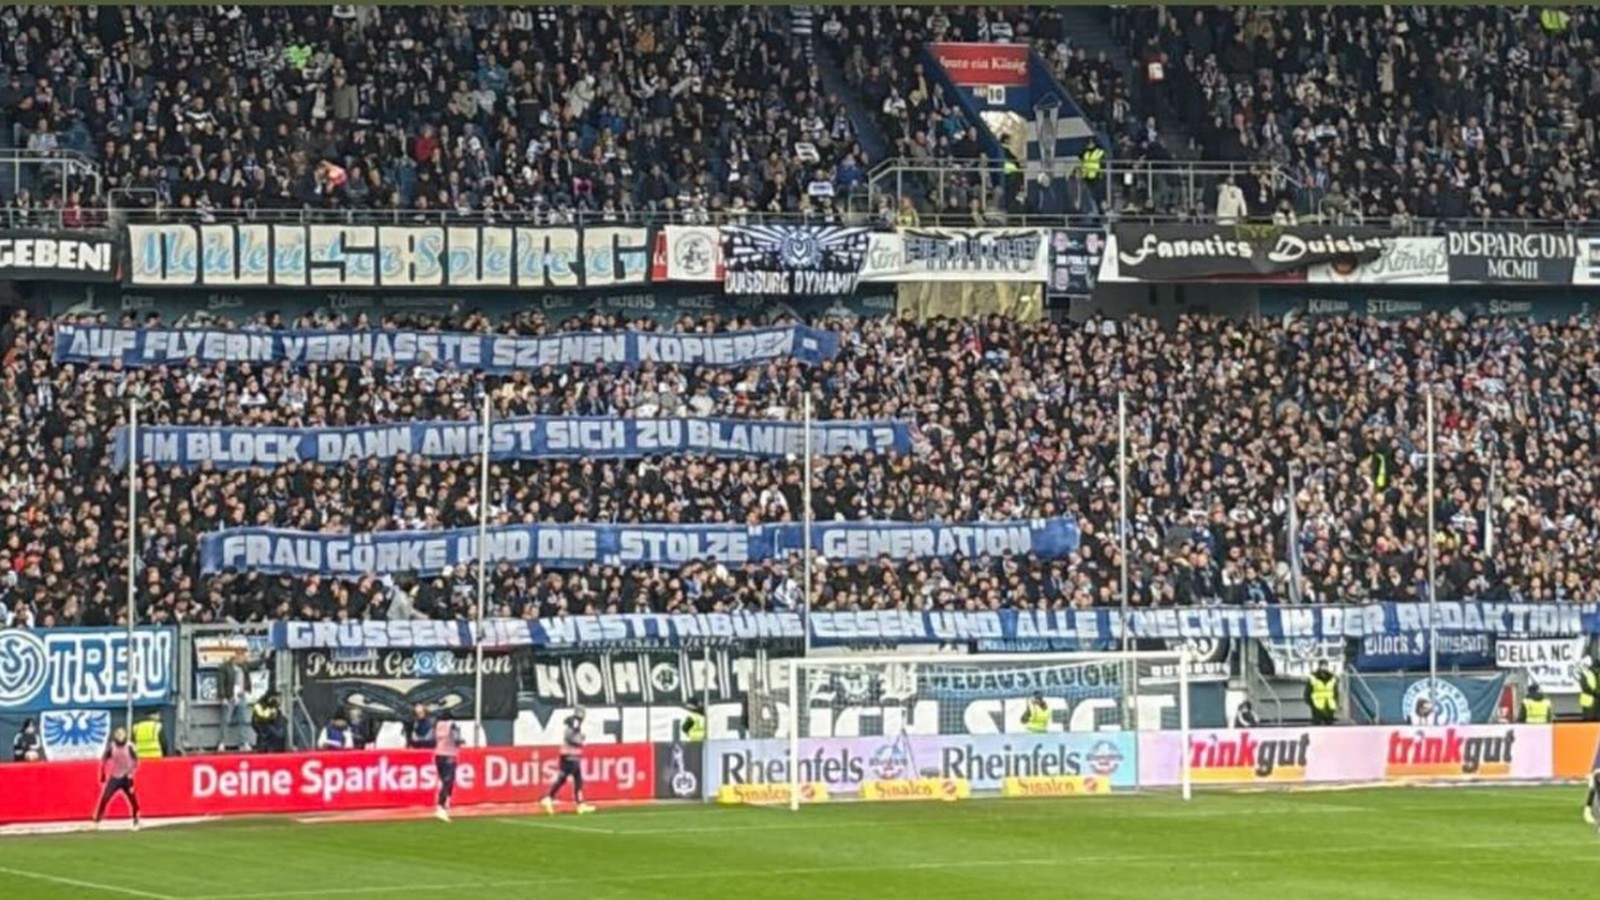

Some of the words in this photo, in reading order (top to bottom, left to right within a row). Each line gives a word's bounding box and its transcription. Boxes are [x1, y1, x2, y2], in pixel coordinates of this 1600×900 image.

[0, 238, 112, 272] GEBEN!
[127, 224, 648, 287] DUISBURG
[1450, 231, 1575, 259] DISPARGUM
[724, 270, 790, 294] DUISBURG
[1488, 259, 1538, 280] MCMII
[143, 331, 272, 359] FLYERN
[283, 332, 481, 359] VERHASSTE
[492, 336, 626, 367] SZENEN
[143, 432, 178, 461] IM
[186, 432, 301, 463] BLOCK
[317, 426, 412, 463] DANN
[421, 421, 535, 456] ANGST
[546, 418, 625, 451] SICH
[636, 418, 681, 449] ZU
[223, 534, 321, 570] FRAU
[327, 534, 448, 572] GÖRKE
[457, 529, 530, 563] UND
[537, 529, 597, 560] DIE
[540, 608, 805, 644] WESTTRIBÜNE
[811, 610, 926, 638] ESSEN
[929, 609, 1002, 639] UND
[1016, 608, 1099, 638] ALLE
[1109, 606, 1270, 639] KNECHTE
[1280, 607, 1315, 637] IN
[1321, 603, 1385, 638] DER
[45, 630, 172, 704] TREU
[306, 650, 380, 678] Proud
[721, 747, 865, 785] Rheinfels
[942, 743, 1081, 781] Rheinfels
[1387, 728, 1516, 774] trinkgut
[192, 759, 293, 798] Deine
[301, 756, 476, 802] Sparkase
[484, 751, 647, 790] Duisurg.
[1018, 778, 1075, 795] Sinalco
